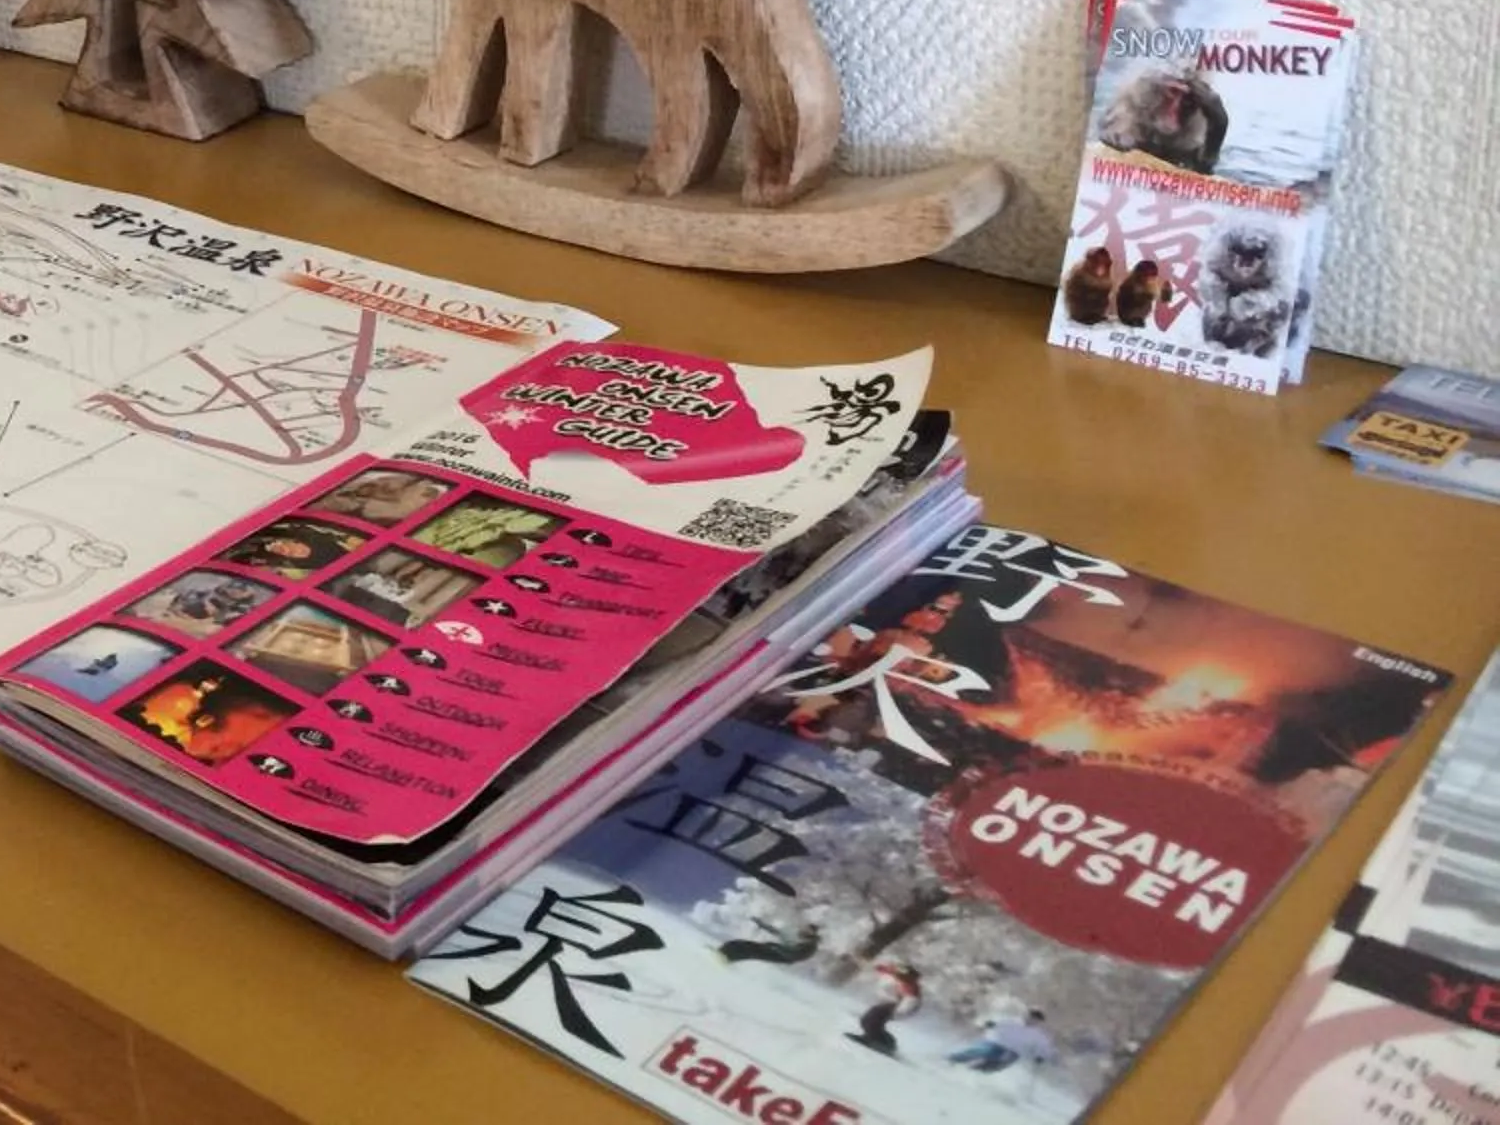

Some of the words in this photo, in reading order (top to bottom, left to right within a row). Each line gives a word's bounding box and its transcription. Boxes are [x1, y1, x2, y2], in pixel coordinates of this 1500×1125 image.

[1111, 26, 1203, 58] SNOW
[1209, 28, 1260, 44] TOUR
[1196, 43, 1333, 77] MONKEY
[74, 202, 284, 276] 野沢温泉
[1063, 334, 1099, 358] TEL
[558, 354, 721, 390] NOZAWA
[503, 385, 652, 426] WINTER
[600, 379, 736, 420] ONSEN
[427, 430, 481, 445] 2016
[555, 418, 687, 459] GUIDE
[1380, 416, 1462, 446] TAXI
[1352, 645, 1440, 684] English
[416, 695, 510, 731] OUTDOOR
[994, 786, 1249, 906] NOZAWA
[970, 813, 1235, 934] ONSEN
